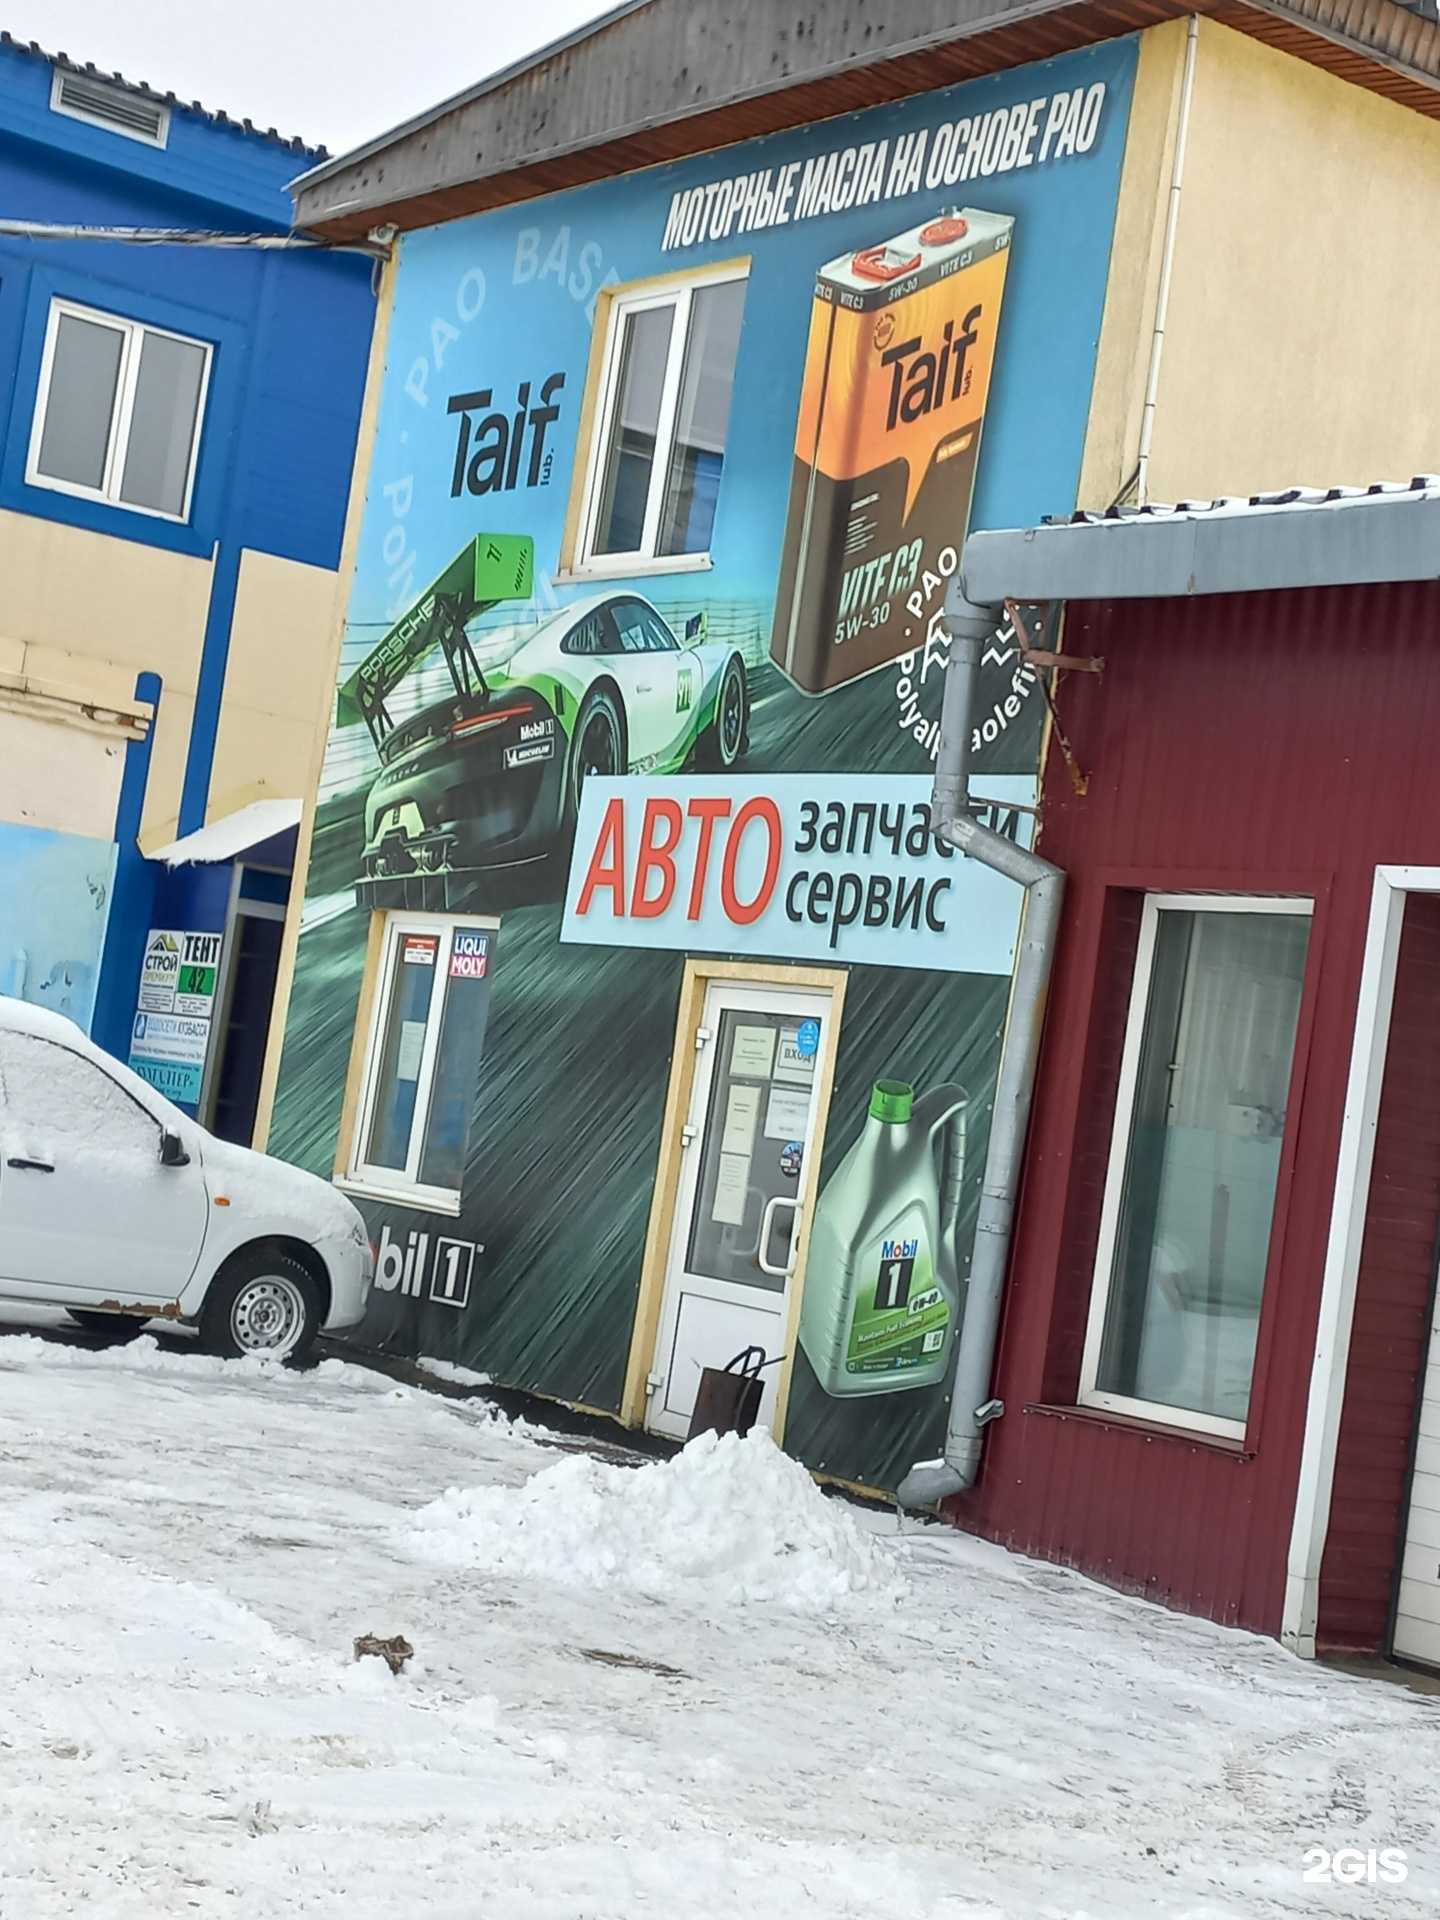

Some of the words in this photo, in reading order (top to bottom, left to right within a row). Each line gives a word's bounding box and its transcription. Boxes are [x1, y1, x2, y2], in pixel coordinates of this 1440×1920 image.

[661, 160, 801, 251] МОТОРНЫЕ
[794, 138, 890, 220] МАСЛА
[884, 128, 930, 199] НА
[925, 97, 1047, 189] ОСНОВЕ
[404, 266, 486, 406] PAO
[881, 303, 982, 432] Taif
[447, 372, 566, 498] Taif
[540, 447, 554, 486] lub.
[906, 547, 958, 618] PAO
[360, 594, 436, 680] PORSCHE
[834, 601, 890, 644] 5W-30
[575, 796, 783, 925] АВТО
[785, 870, 951, 948] сервис
[145, 954, 178, 972] СТРОЙ
[185, 936, 220, 963] ТЕНТ
[450, 955, 487, 976] MOLY
[454, 935, 487, 956] LIQUI
[188, 967, 206, 993] 42
[881, 1239, 918, 1260] Mobil
[887, 1262, 902, 1307] 1
